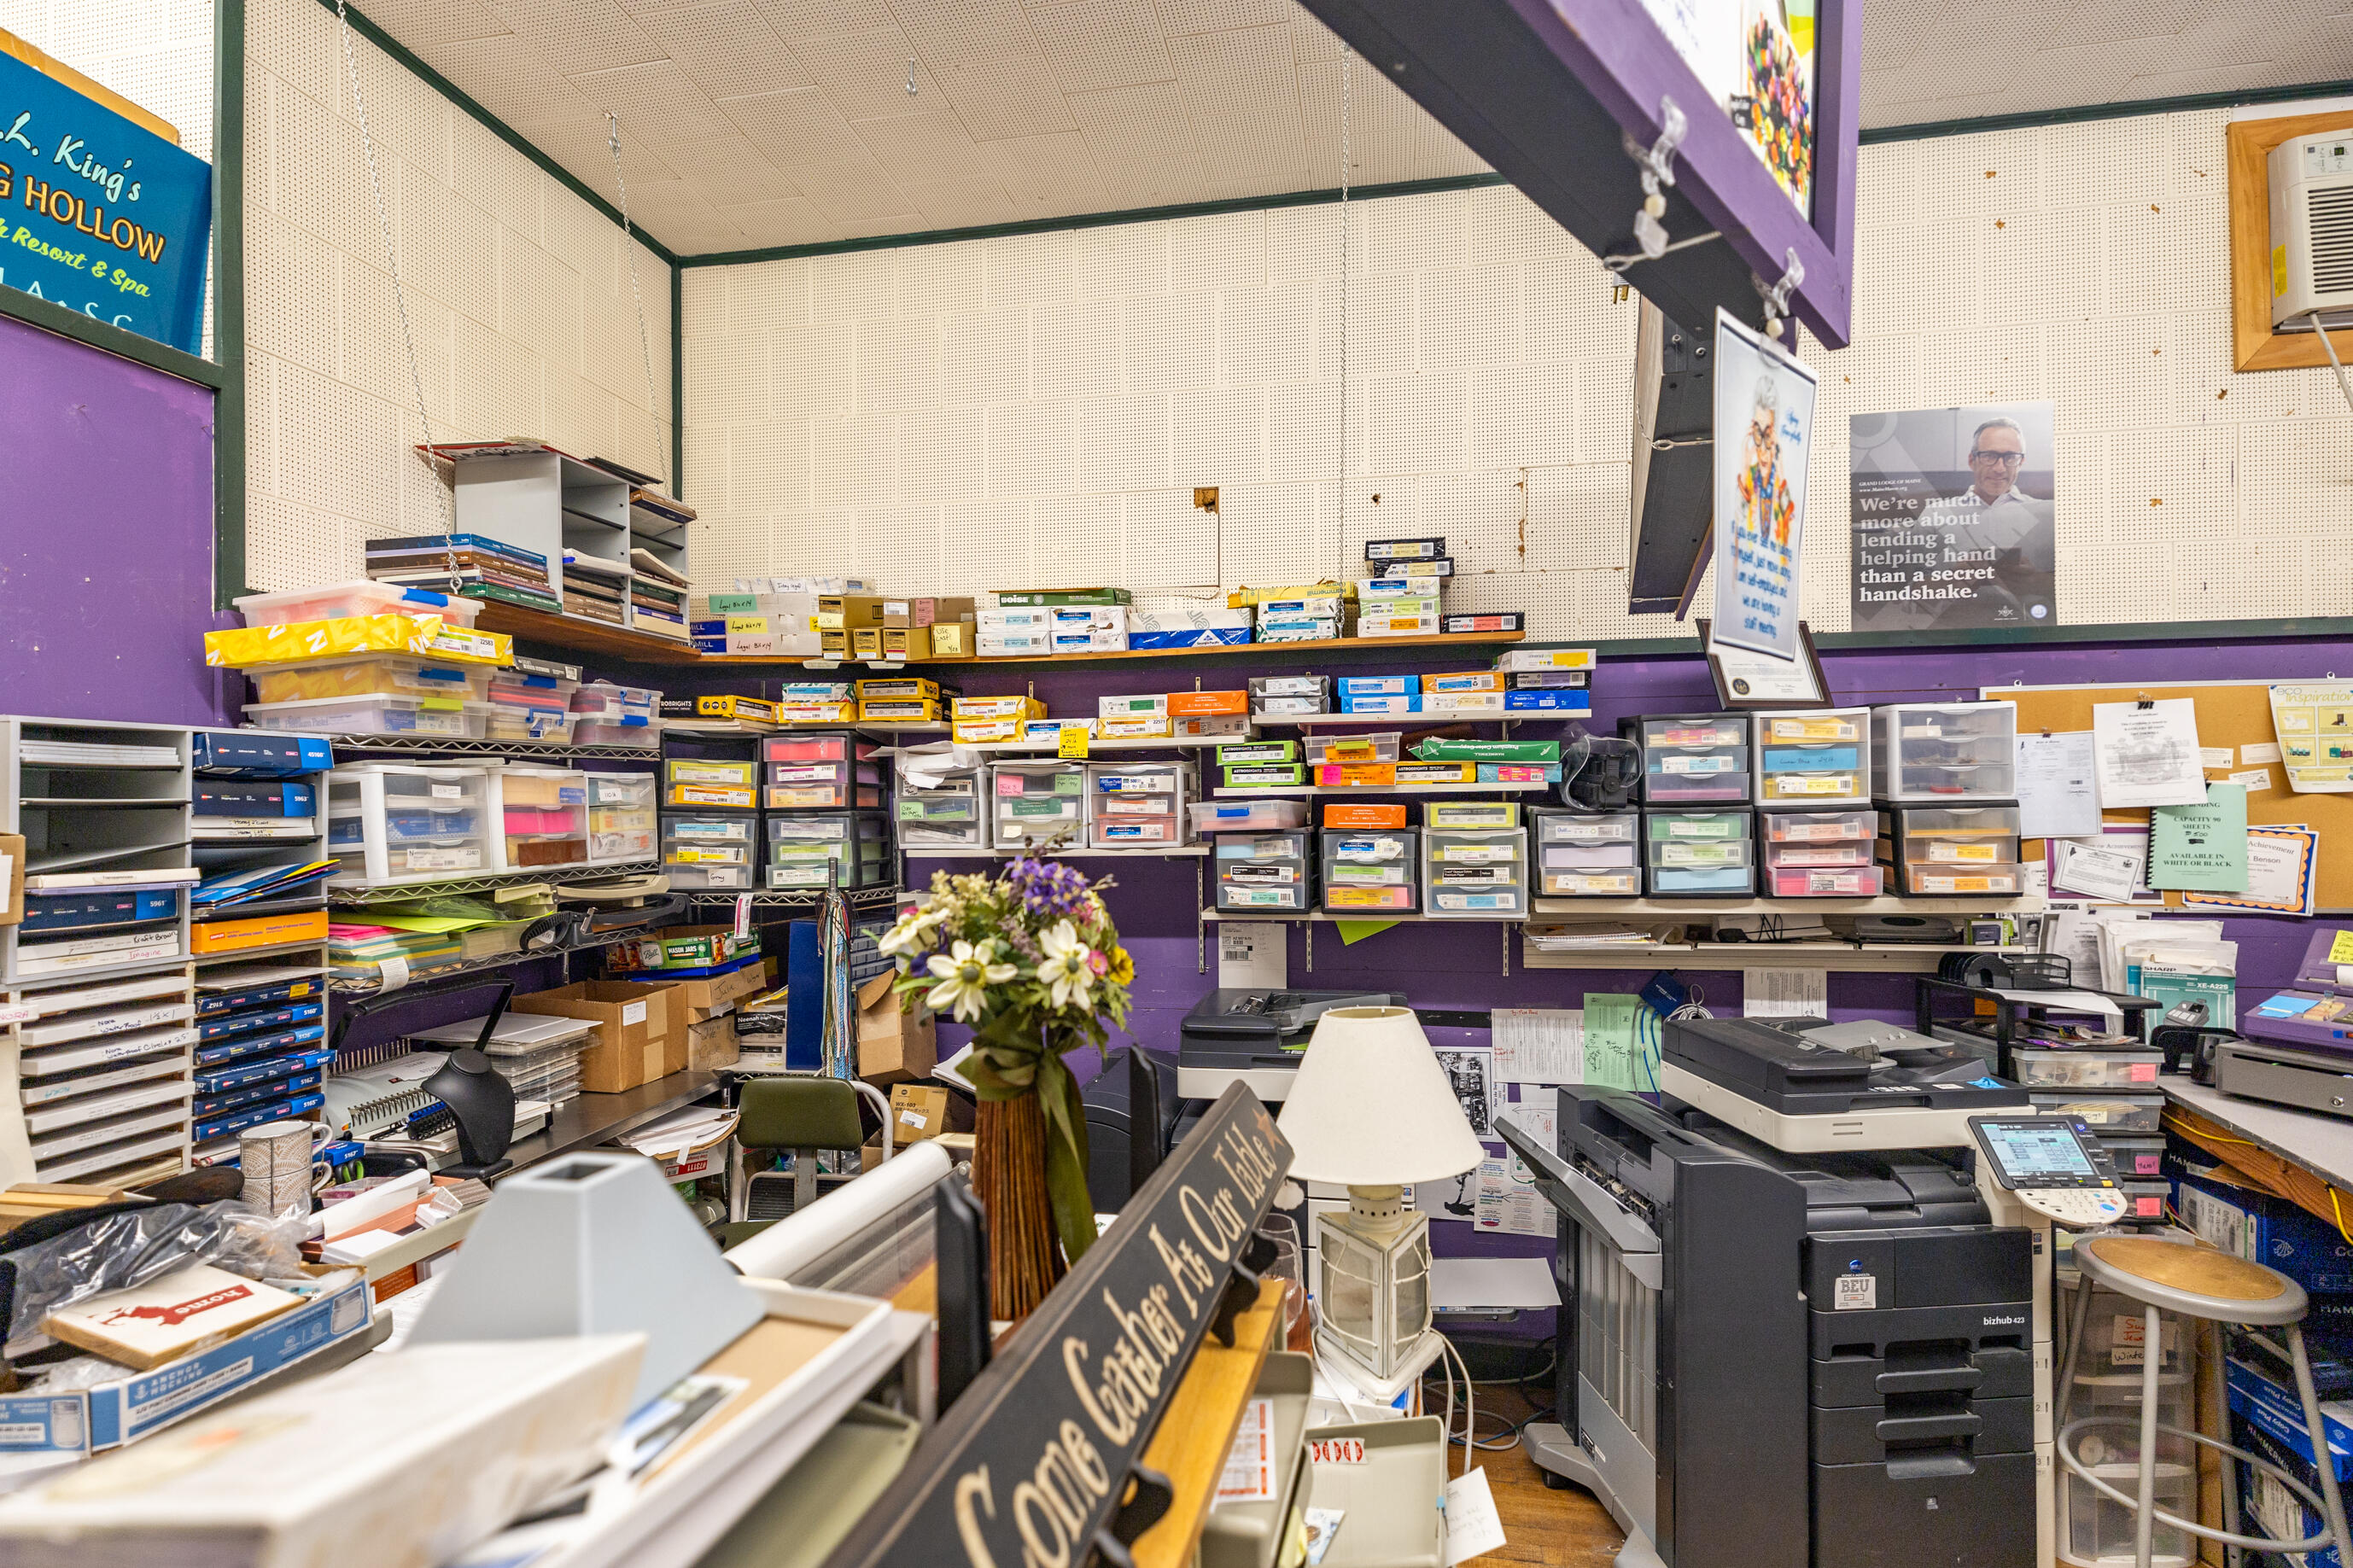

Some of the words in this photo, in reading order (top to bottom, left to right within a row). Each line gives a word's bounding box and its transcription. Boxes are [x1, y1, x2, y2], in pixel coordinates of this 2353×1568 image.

[53, 134, 141, 203] King's
[24, 175, 166, 265] HOLLOW
[12, 226, 89, 271] Resort
[91, 260, 108, 278] &
[109, 268, 151, 298] Spa
[1924, 494, 1982, 509] much
[1860, 517, 1914, 530] more
[1921, 512, 1980, 527] about
[1860, 532, 1938, 549] lending
[1944, 533, 1956, 544] a
[1860, 550, 1937, 568] helping
[1943, 546, 1996, 562] hand
[1860, 569, 1906, 583] than
[1912, 571, 1924, 582] a
[1931, 566, 1995, 581] secret
[1860, 585, 1978, 602] handshake.
[2247, 840, 2295, 855] Achievement
[2253, 855, 2281, 864] Benson
[669, 945, 684, 953] MASON
[685, 945, 698, 953] JARS
[1212, 1122, 1277, 1212] Table
[1179, 1185, 1248, 1263] Our
[1148, 1222, 1214, 1320] At
[1841, 1279, 1870, 1293] BEU
[173, 1286, 245, 1314] home
[1983, 1315, 2012, 1326] bizhub
[1062, 1284, 1187, 1447] Gather
[955, 1419, 1112, 1568] Come
